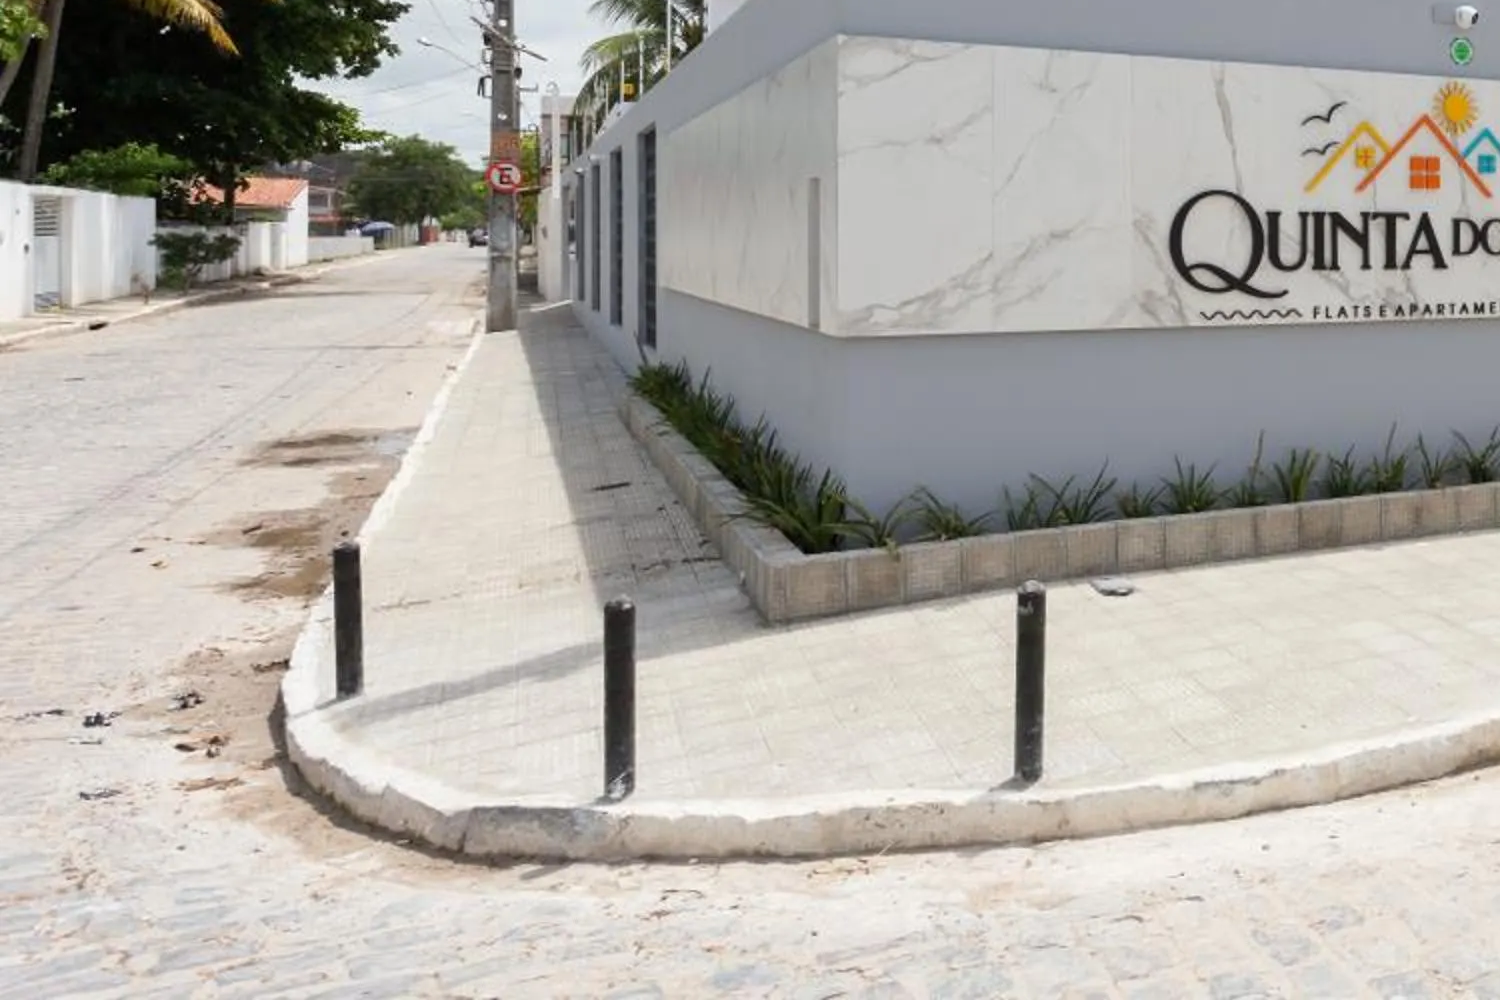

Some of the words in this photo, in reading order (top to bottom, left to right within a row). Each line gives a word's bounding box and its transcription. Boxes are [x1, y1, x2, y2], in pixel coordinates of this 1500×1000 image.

[1168, 188, 1448, 299] QUINTA
[1312, 304, 1372, 320] FLATS
[1378, 303, 1388, 318] E
